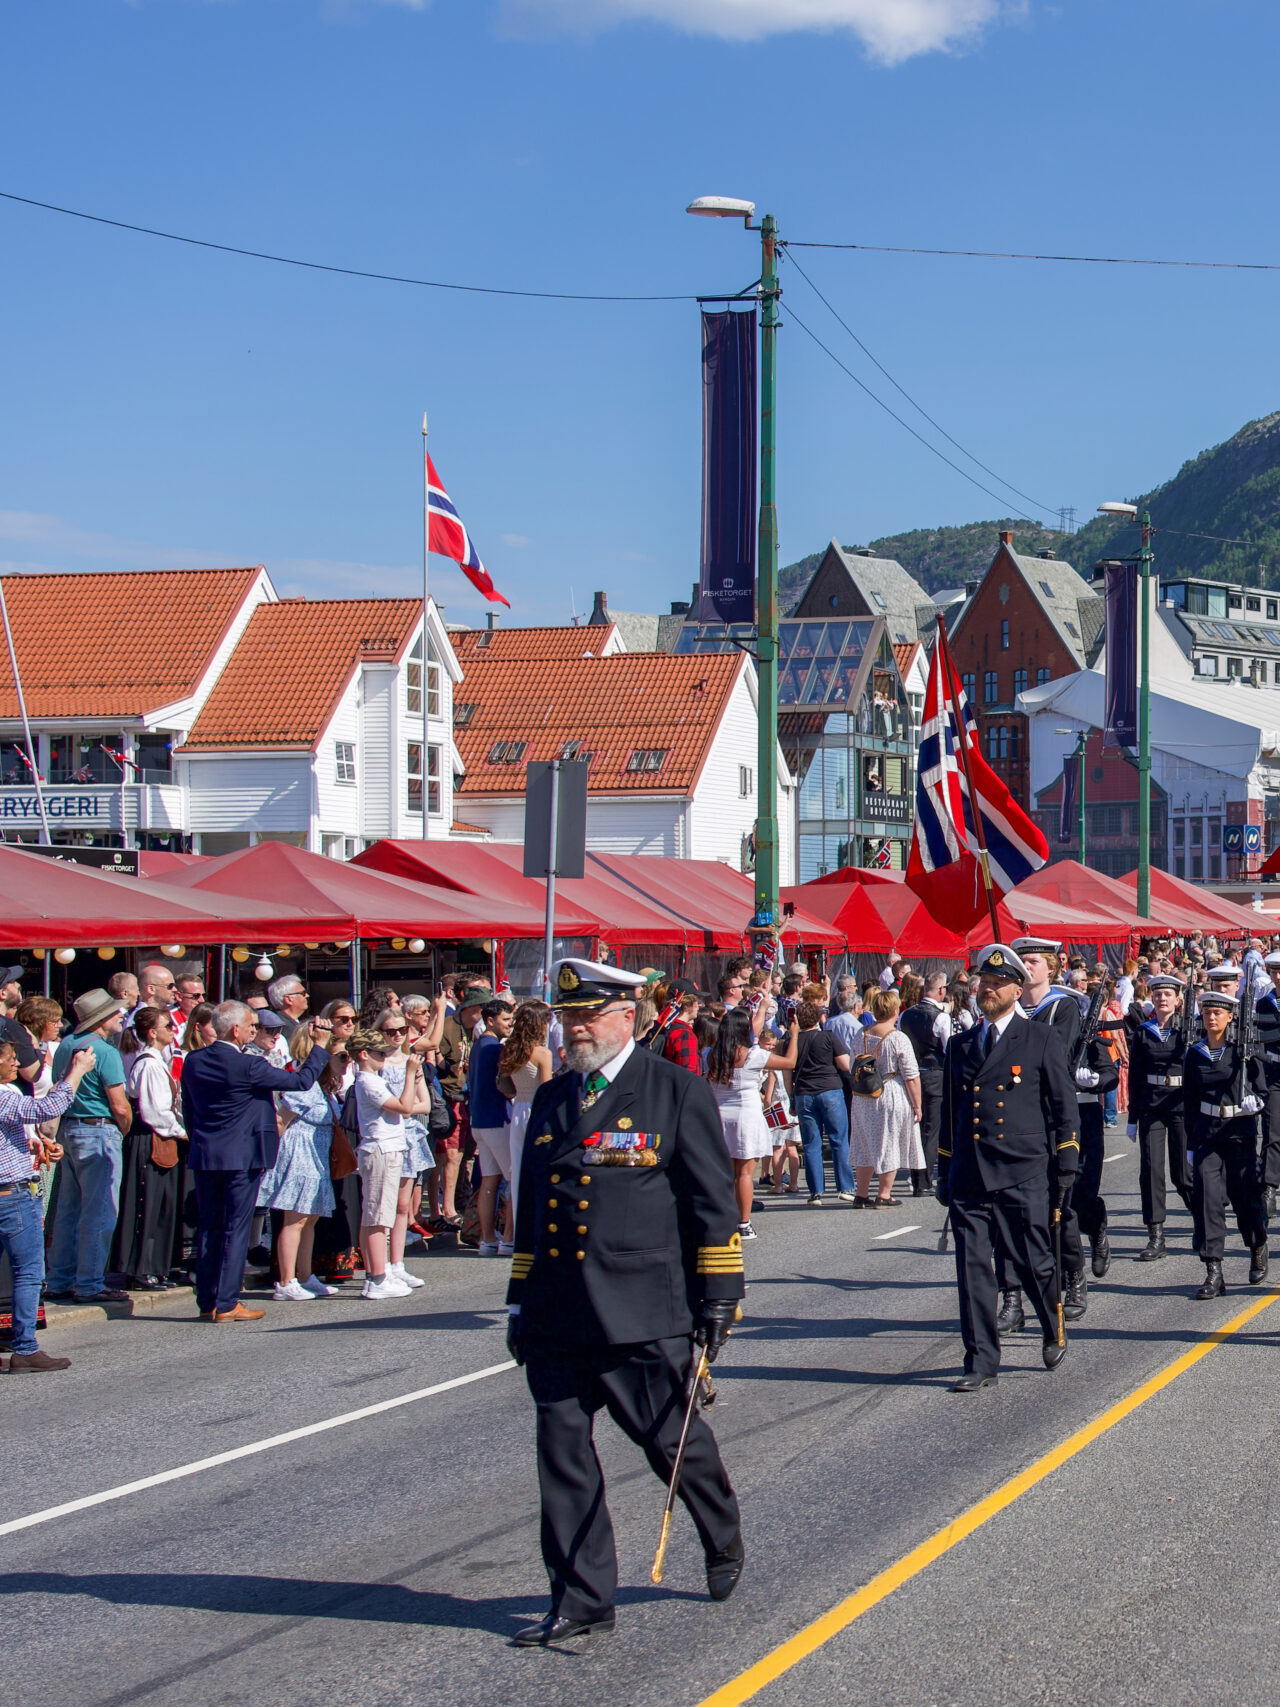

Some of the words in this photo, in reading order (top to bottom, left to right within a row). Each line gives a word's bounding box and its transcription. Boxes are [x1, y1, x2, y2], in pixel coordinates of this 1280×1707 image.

[702, 589, 752, 598] FISKETORGET
[0, 796, 98, 817] RYGGERI
[865, 797, 908, 809] RESTAURANT
[870, 807, 903, 818] BRYGGERI
[101, 864, 135, 872] FISKETORGET
